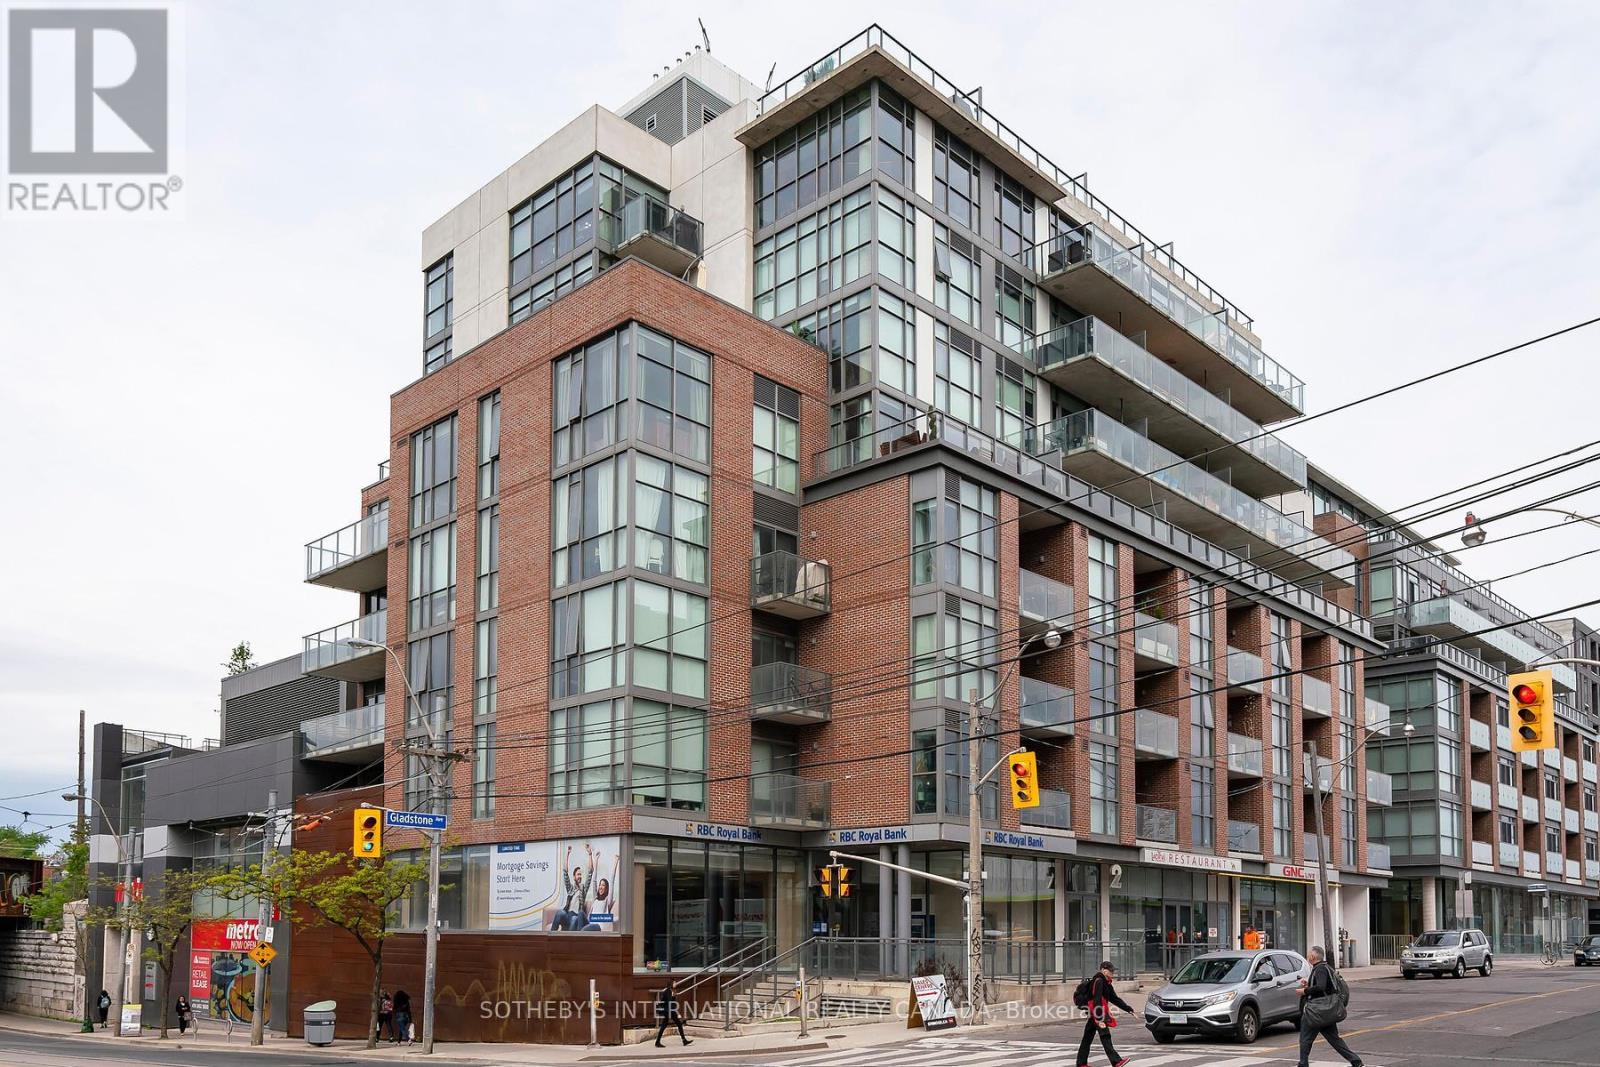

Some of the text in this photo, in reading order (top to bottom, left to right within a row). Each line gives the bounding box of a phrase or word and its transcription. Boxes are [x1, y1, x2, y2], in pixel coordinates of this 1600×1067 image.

[390, 812, 434, 825] Gladstone
[697, 824, 762, 841] RBC Royal Bank
[839, 828, 907, 843] RBC Royal Bank
[993, 831, 1044, 848] RBC Royal Bank
[497, 860, 550, 873] Mortgage Savings
[1168, 853, 1226, 869] RESTAURANT
[1110, 864, 1122, 888] 2
[1282, 865, 1304, 878] GNC
[496, 874, 526, 883] Start Here
[230, 940, 257, 950] NOW OPEN
[192, 969, 208, 979] RETAIL
